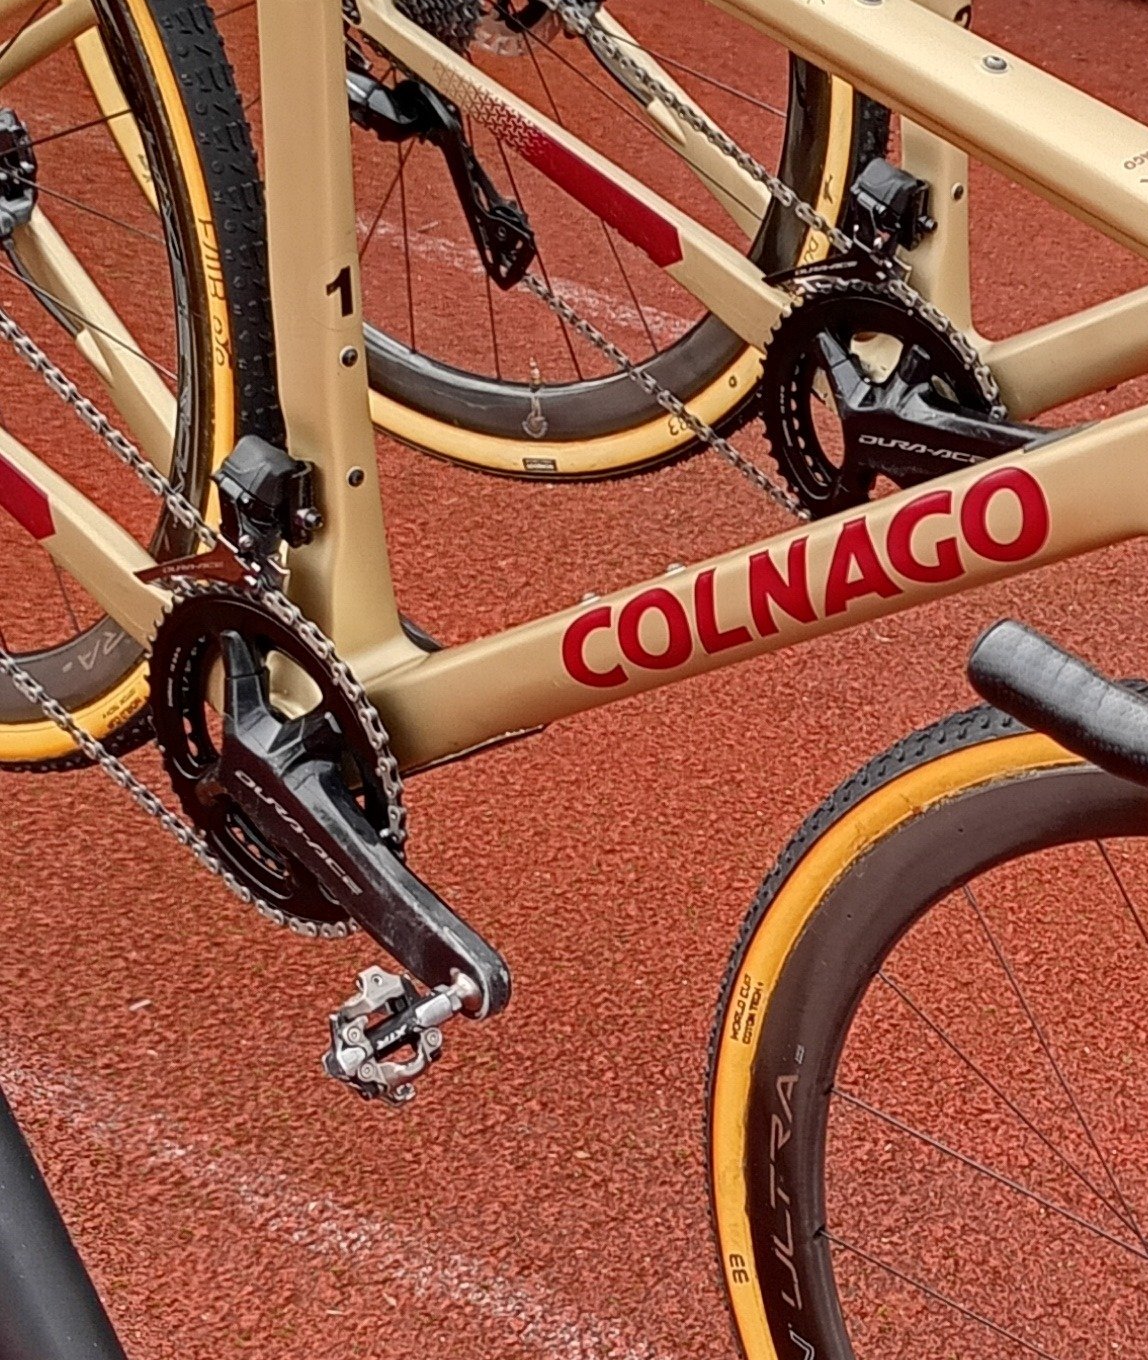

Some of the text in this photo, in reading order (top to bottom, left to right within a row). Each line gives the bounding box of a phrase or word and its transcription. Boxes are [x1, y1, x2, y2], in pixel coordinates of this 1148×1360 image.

[325, 266, 354, 318] 1
[560, 465, 1051, 690] COLNAGO
[234, 769, 363, 896] DURA-ACE
[769, 1072, 804, 1311] ULTRA
